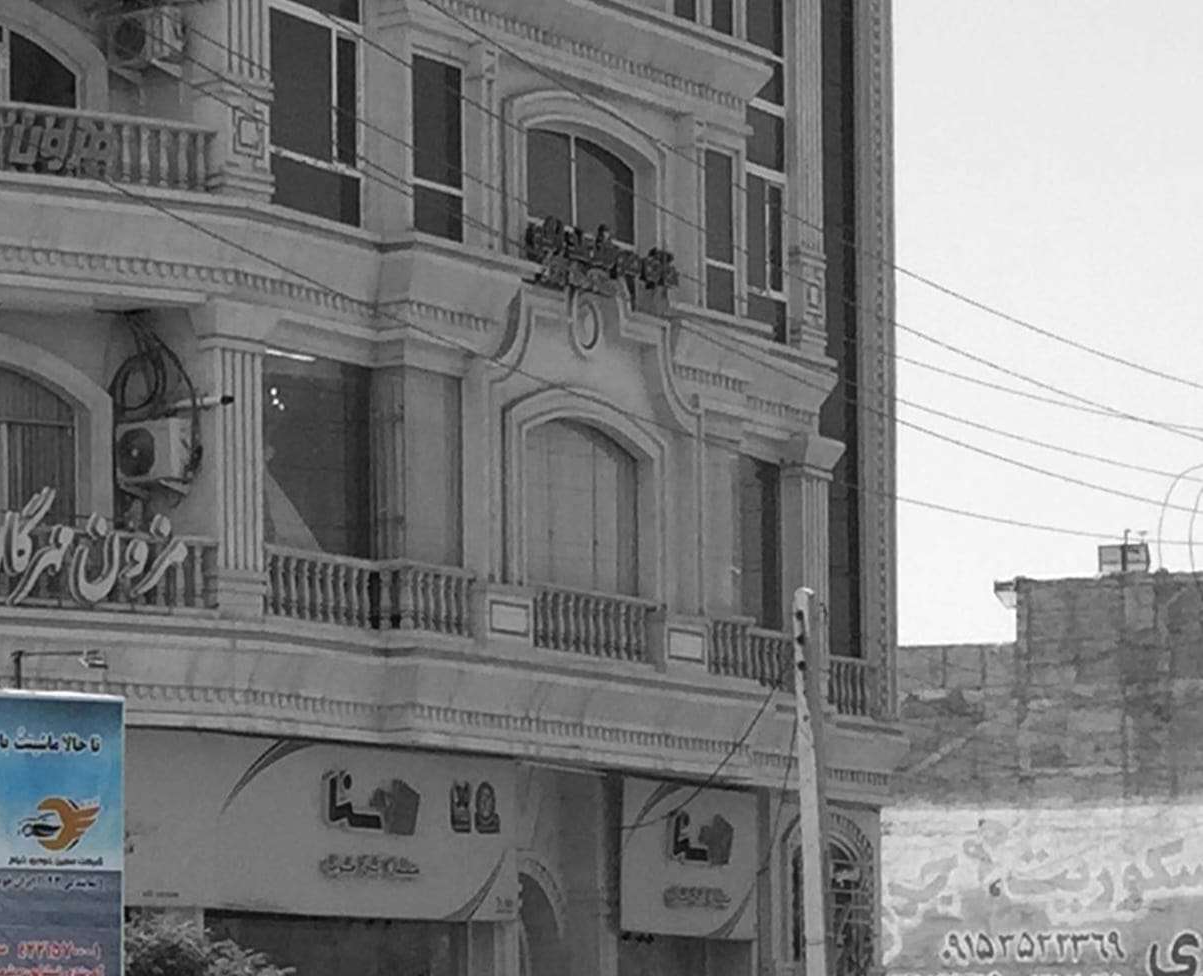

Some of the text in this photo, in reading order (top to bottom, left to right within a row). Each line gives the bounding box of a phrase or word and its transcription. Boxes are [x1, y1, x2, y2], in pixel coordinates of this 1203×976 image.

[69, 511, 188, 602] مزون
[62, 733, 88, 752] حالا
[90, 733, 102, 753] تا
